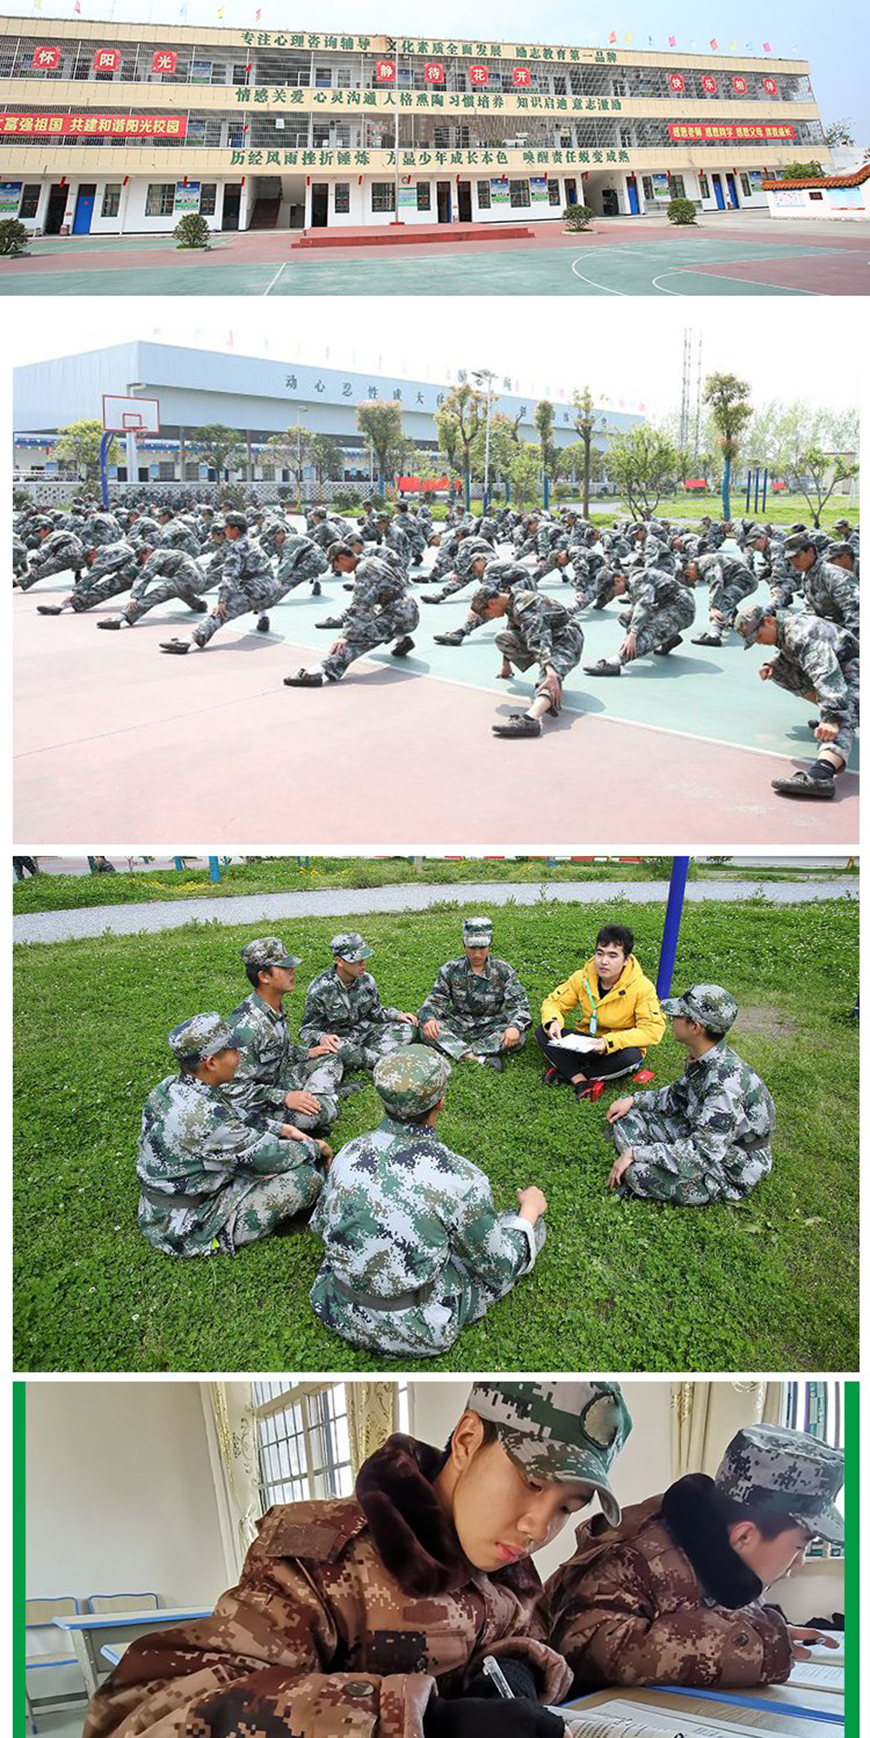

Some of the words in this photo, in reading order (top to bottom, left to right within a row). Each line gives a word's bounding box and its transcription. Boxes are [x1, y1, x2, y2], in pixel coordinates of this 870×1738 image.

[241, 31, 371, 51] 专注心理咨询辅导
[386, 37, 502, 57] 文化素质全面发展
[515, 46, 618, 63] 励志教育第一品牌
[38, 51, 55, 64] 怀
[99, 53, 115, 66] 阳
[157, 55, 172, 69] 光
[379, 64, 393, 78] 静
[427, 66, 439, 79] 待
[473, 69, 486, 82] 花
[516, 71, 527, 82] 开
[672, 78, 683, 89] 快
[705, 78, 714, 90] 乐
[235, 87, 305, 104] 情感关爱
[313, 91, 378, 106] 心灵沟通
[383, 92, 444, 108] 人格熏陶
[449, 96, 504, 109] 习惯培养
[516, 96, 568, 111] 知识启迪
[571, 97, 622, 111] 意志激励
[0, 117, 64, 132] 富强祖国
[69, 119, 180, 134] 共建和谐阳光校园
[230, 150, 370, 166] 历经风雨挫折锤炼
[386, 150, 509, 166] 方显少年成长本色
[522, 150, 631, 165] 唤醒责任蜕变成熟
